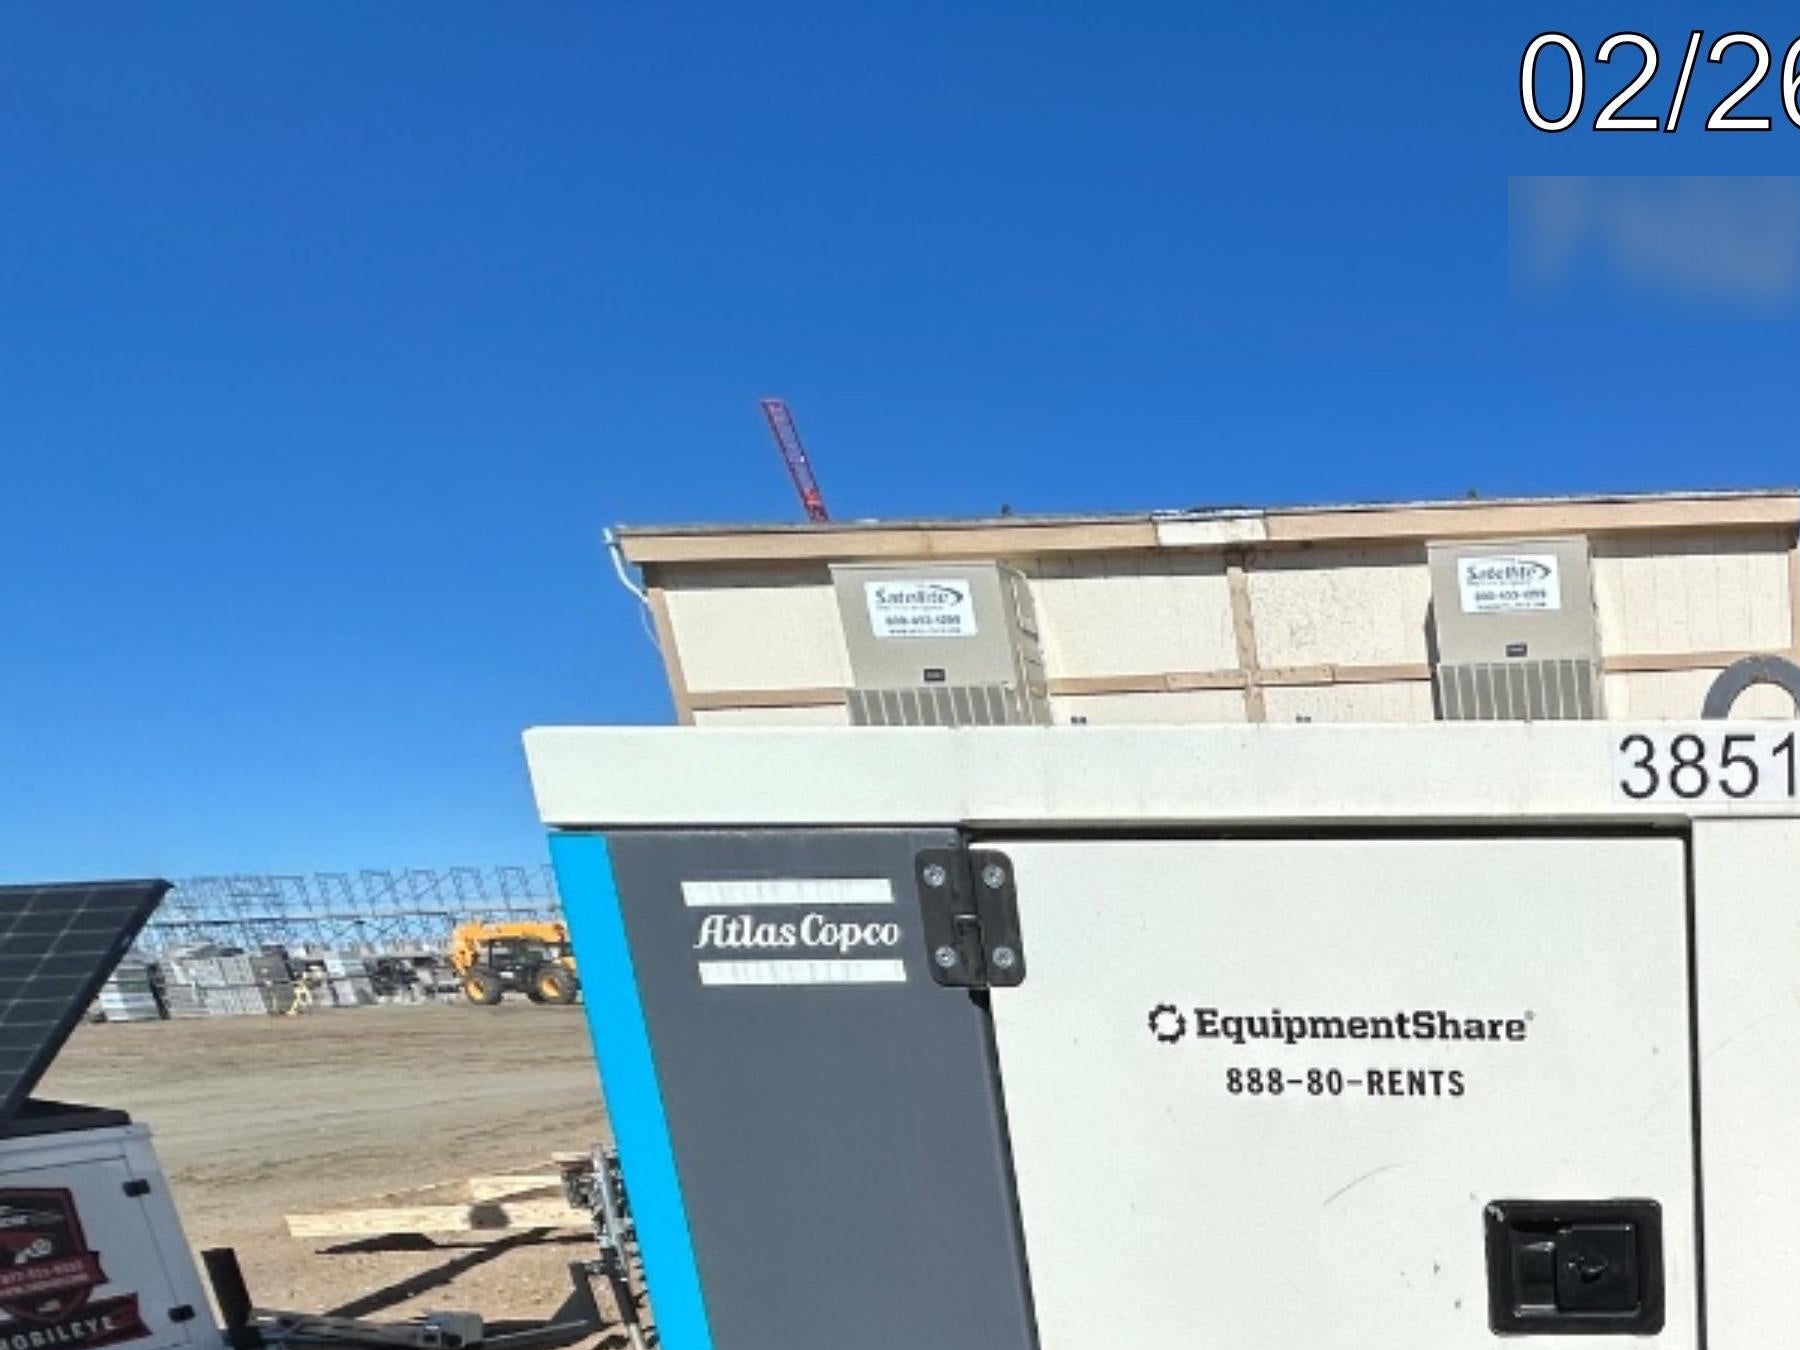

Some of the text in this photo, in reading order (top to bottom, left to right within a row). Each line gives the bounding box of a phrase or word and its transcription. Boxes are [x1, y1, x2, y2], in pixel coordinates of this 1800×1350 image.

[692, 911, 900, 953] Atlas Copco
[1193, 1006, 1528, 1045] EquipmentShare
[1226, 1067, 1466, 1097] 888-80-RENTS
